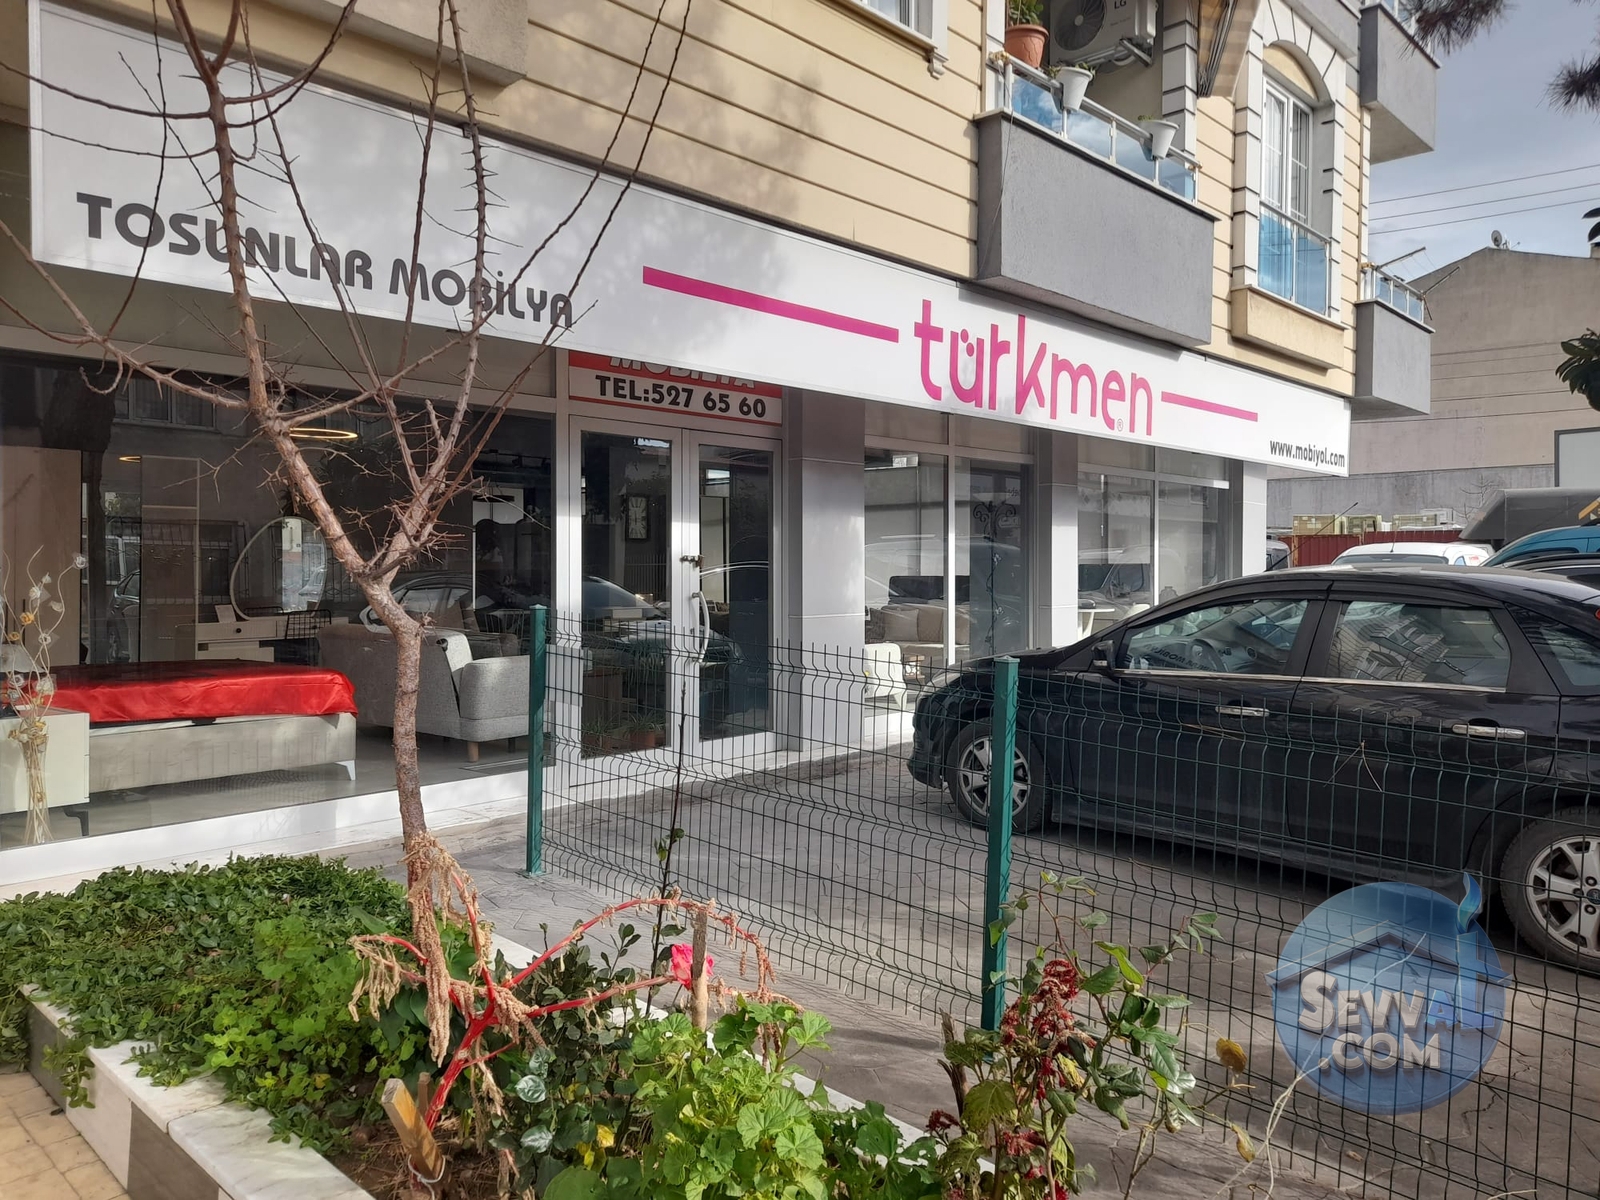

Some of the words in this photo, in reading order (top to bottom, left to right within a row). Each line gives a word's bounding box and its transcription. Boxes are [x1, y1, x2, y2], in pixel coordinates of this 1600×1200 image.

[1114, 0, 1127, 9] LG
[76, 192, 373, 291] TOSUNLAR
[914, 299, 1152, 436] türkmen
[595, 374, 694, 408] TEL:527
[702, 391, 731, 413] 65
[738, 395, 766, 418] 60
[1269, 440, 1345, 467] www.mobiyol.com
